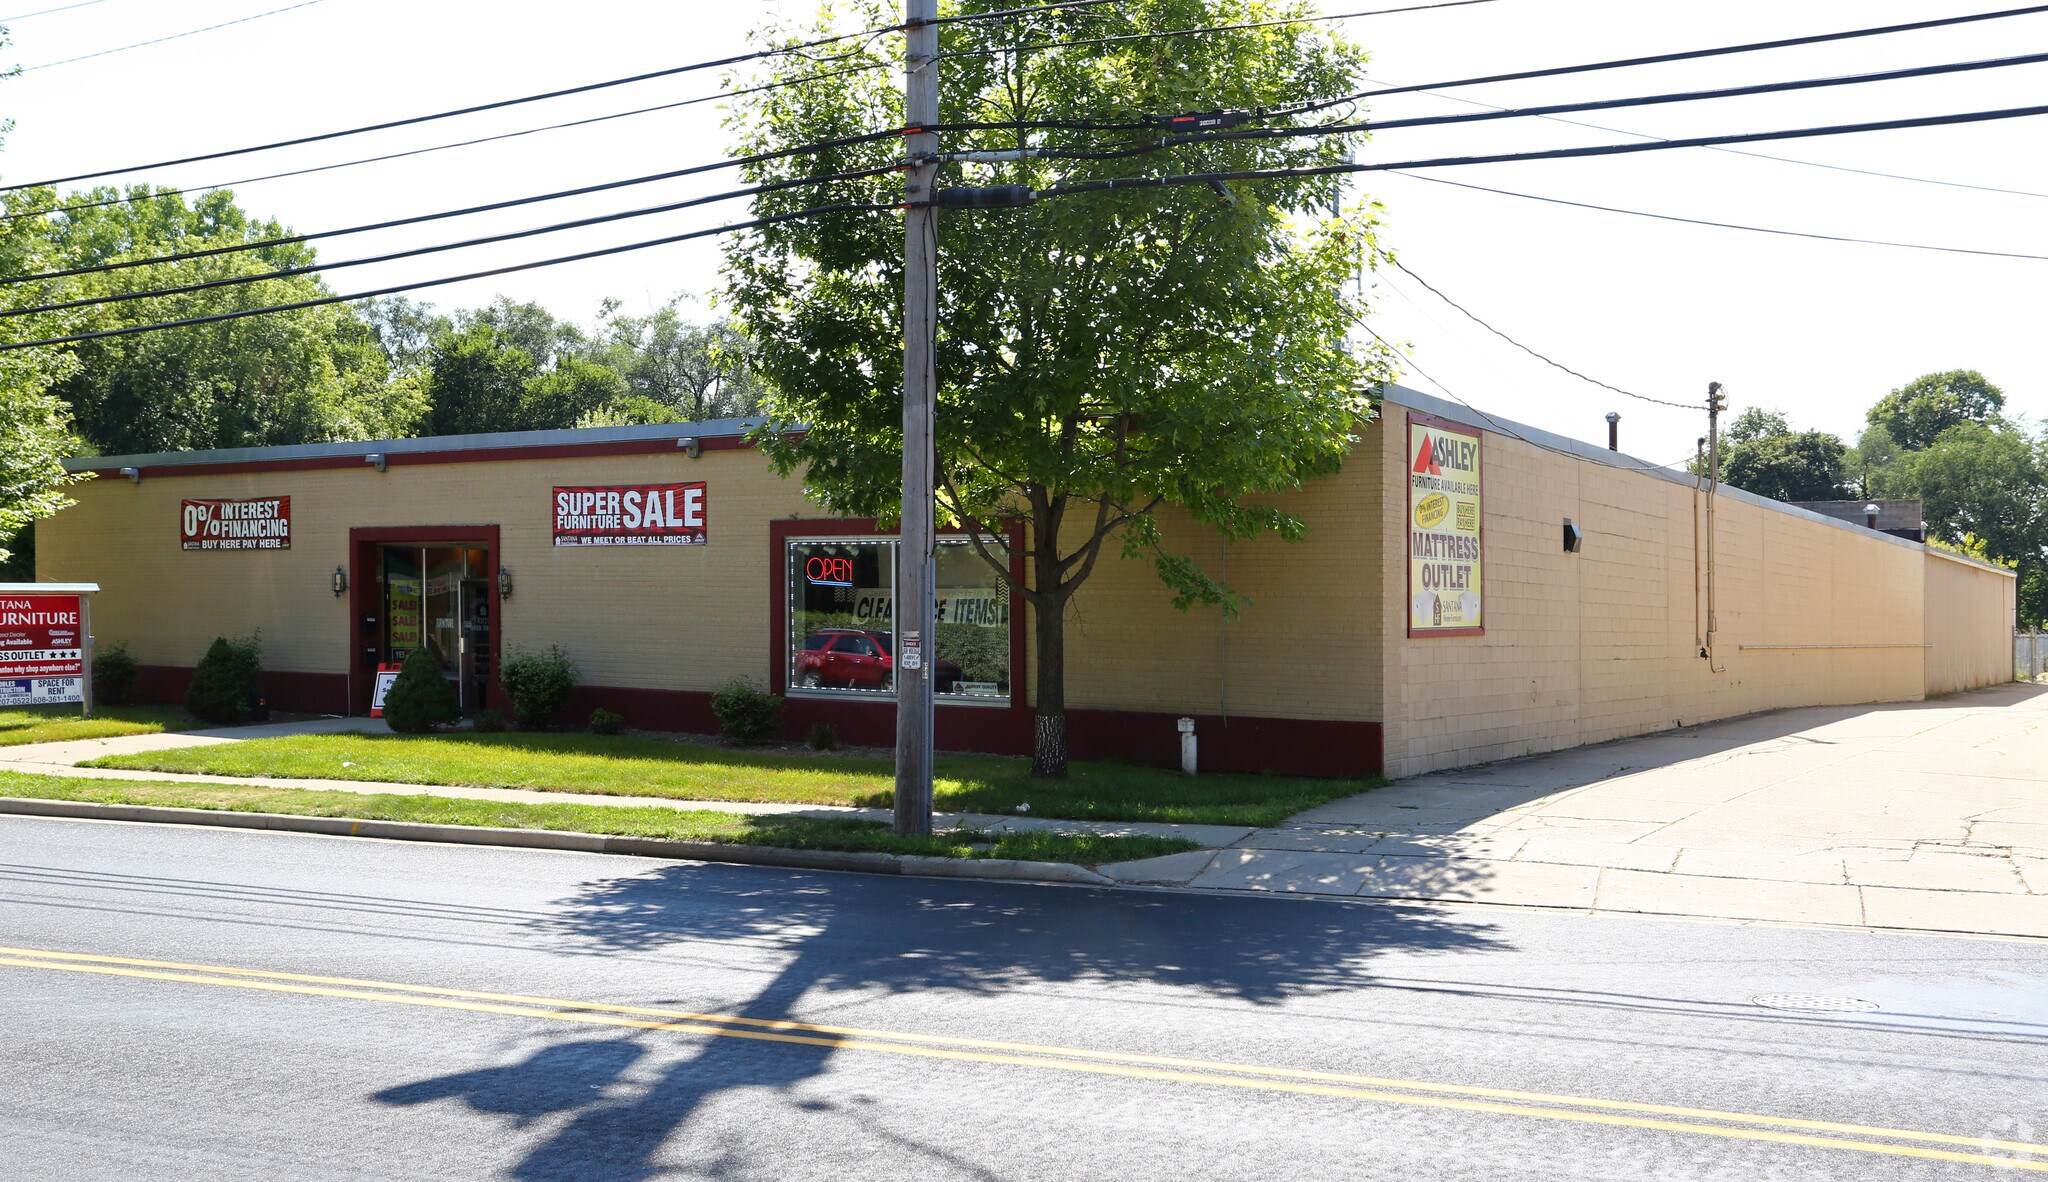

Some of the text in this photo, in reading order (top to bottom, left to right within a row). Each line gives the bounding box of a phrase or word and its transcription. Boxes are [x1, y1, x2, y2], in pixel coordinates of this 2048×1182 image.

[1429, 435, 1477, 472] ASHLEY
[1412, 475, 1478, 496] FURNITURE AVAILABLE HERE
[557, 488, 703, 529] SUPER SALE
[1426, 496, 1444, 511] INTEREST
[184, 500, 280, 537] 0% INTEREST
[557, 514, 621, 529] FURNITURE
[1421, 507, 1443, 523] FINANCING
[221, 518, 288, 538] FINANCING
[201, 540, 217, 549] BUY
[220, 539, 240, 549] HERE
[242, 539, 258, 549] PAY
[259, 538, 281, 548] HERE
[581, 536, 593, 544] WE
[594, 536, 613, 544] MEET
[614, 536, 626, 544] OR
[627, 536, 646, 544] BEAT
[663, 535, 691, 543] PRICES
[1413, 532, 1479, 560] MATTRESS
[806, 556, 853, 582] OPEN
[1422, 563, 1472, 589] OUTLET
[1443, 601, 1463, 613] SANTANA
[11, 651, 45, 660] OUTLET
[14, 665, 25, 675] why
[26, 664, 38, 674] shop
[40, 664, 64, 673] anywhere
[38, 679, 60, 687] SPACE
[48, 687, 65, 695] RENT
[0, 697, 30, 705] 07-0522
[33, 695, 81, 704] 608-361-1400
